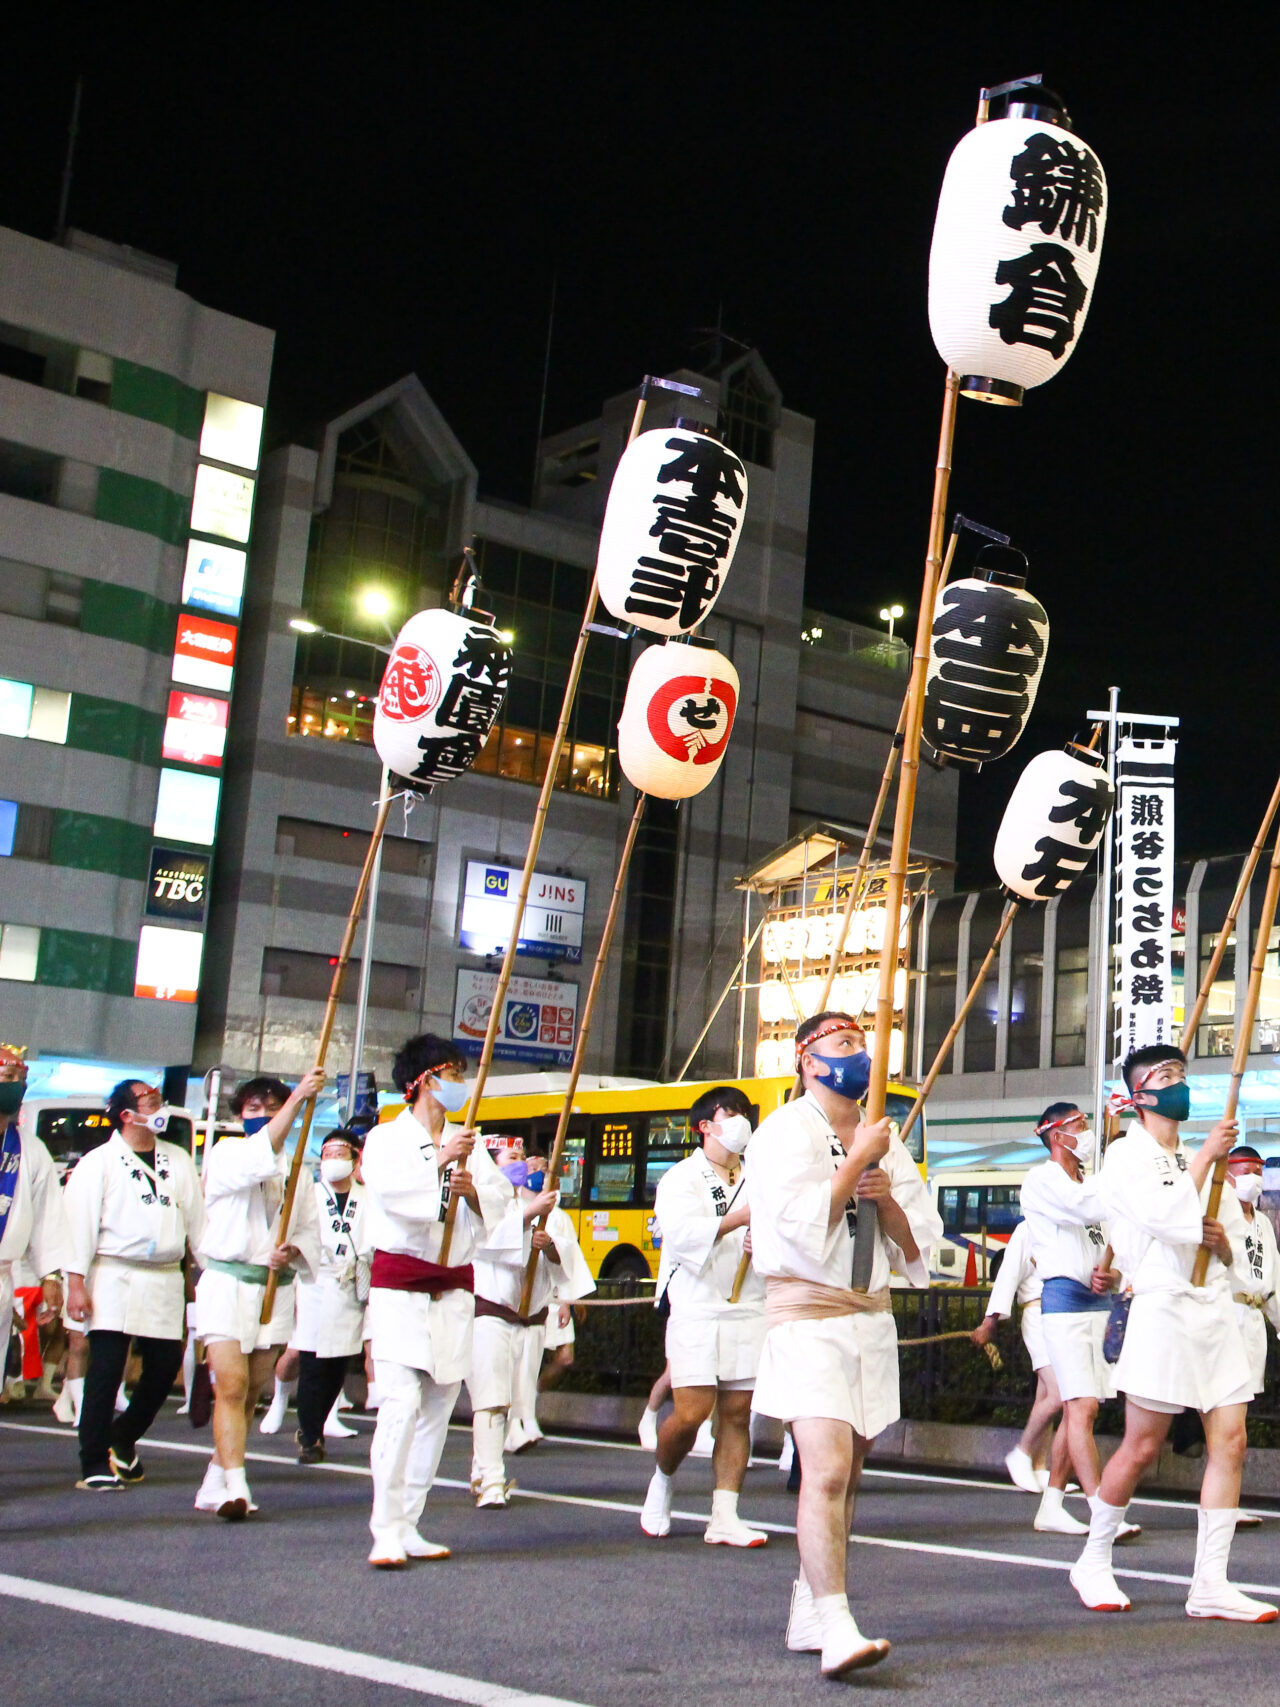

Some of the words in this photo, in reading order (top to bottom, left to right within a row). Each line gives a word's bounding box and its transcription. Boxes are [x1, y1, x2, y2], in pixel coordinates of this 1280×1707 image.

[989, 132, 1107, 360] 鎌倉
[154, 877, 203, 903] TBC
[486, 875, 508, 891] GU
